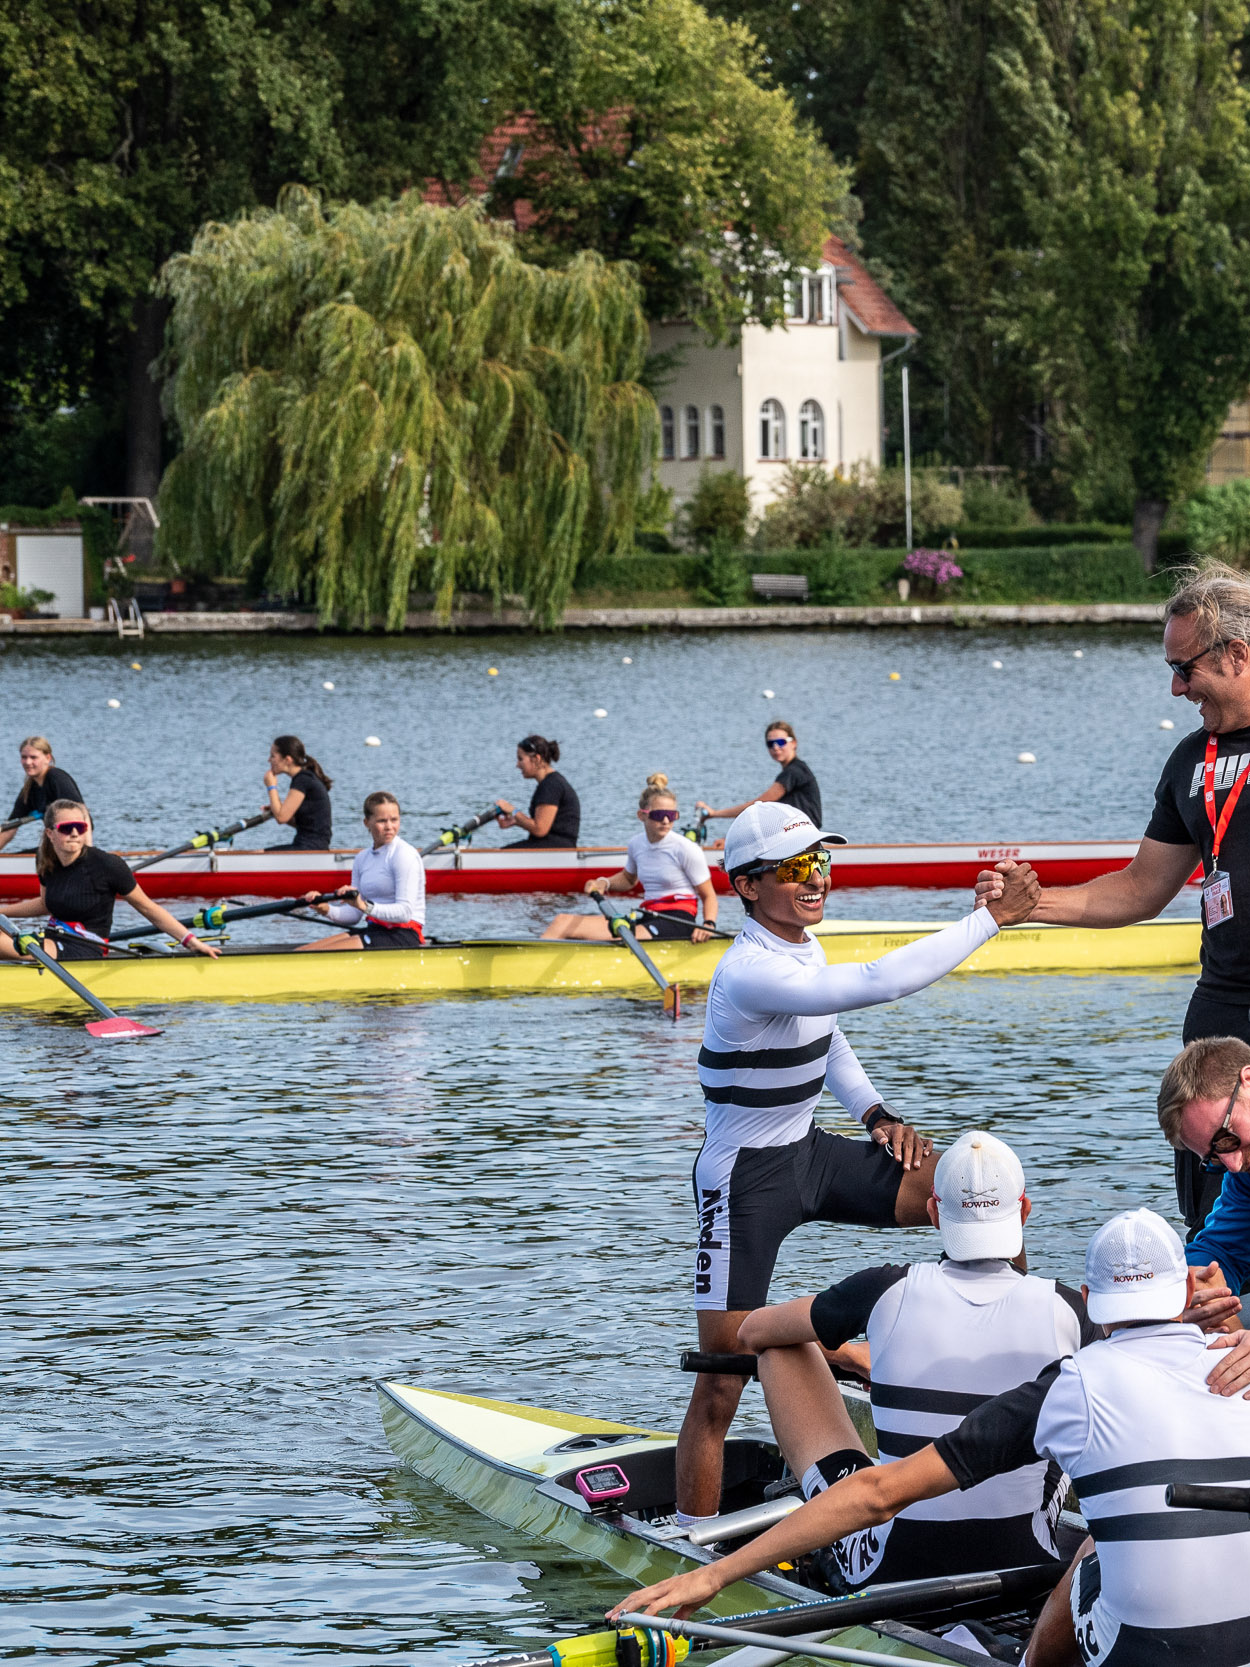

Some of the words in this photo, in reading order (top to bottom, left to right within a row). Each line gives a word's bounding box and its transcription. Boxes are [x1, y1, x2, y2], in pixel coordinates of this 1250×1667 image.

[977, 847, 1021, 858] WESER
[995, 931, 1042, 943] Hamburg
[961, 1199, 1000, 1209] ROWING
[1113, 1272, 1154, 1283] ROWING
